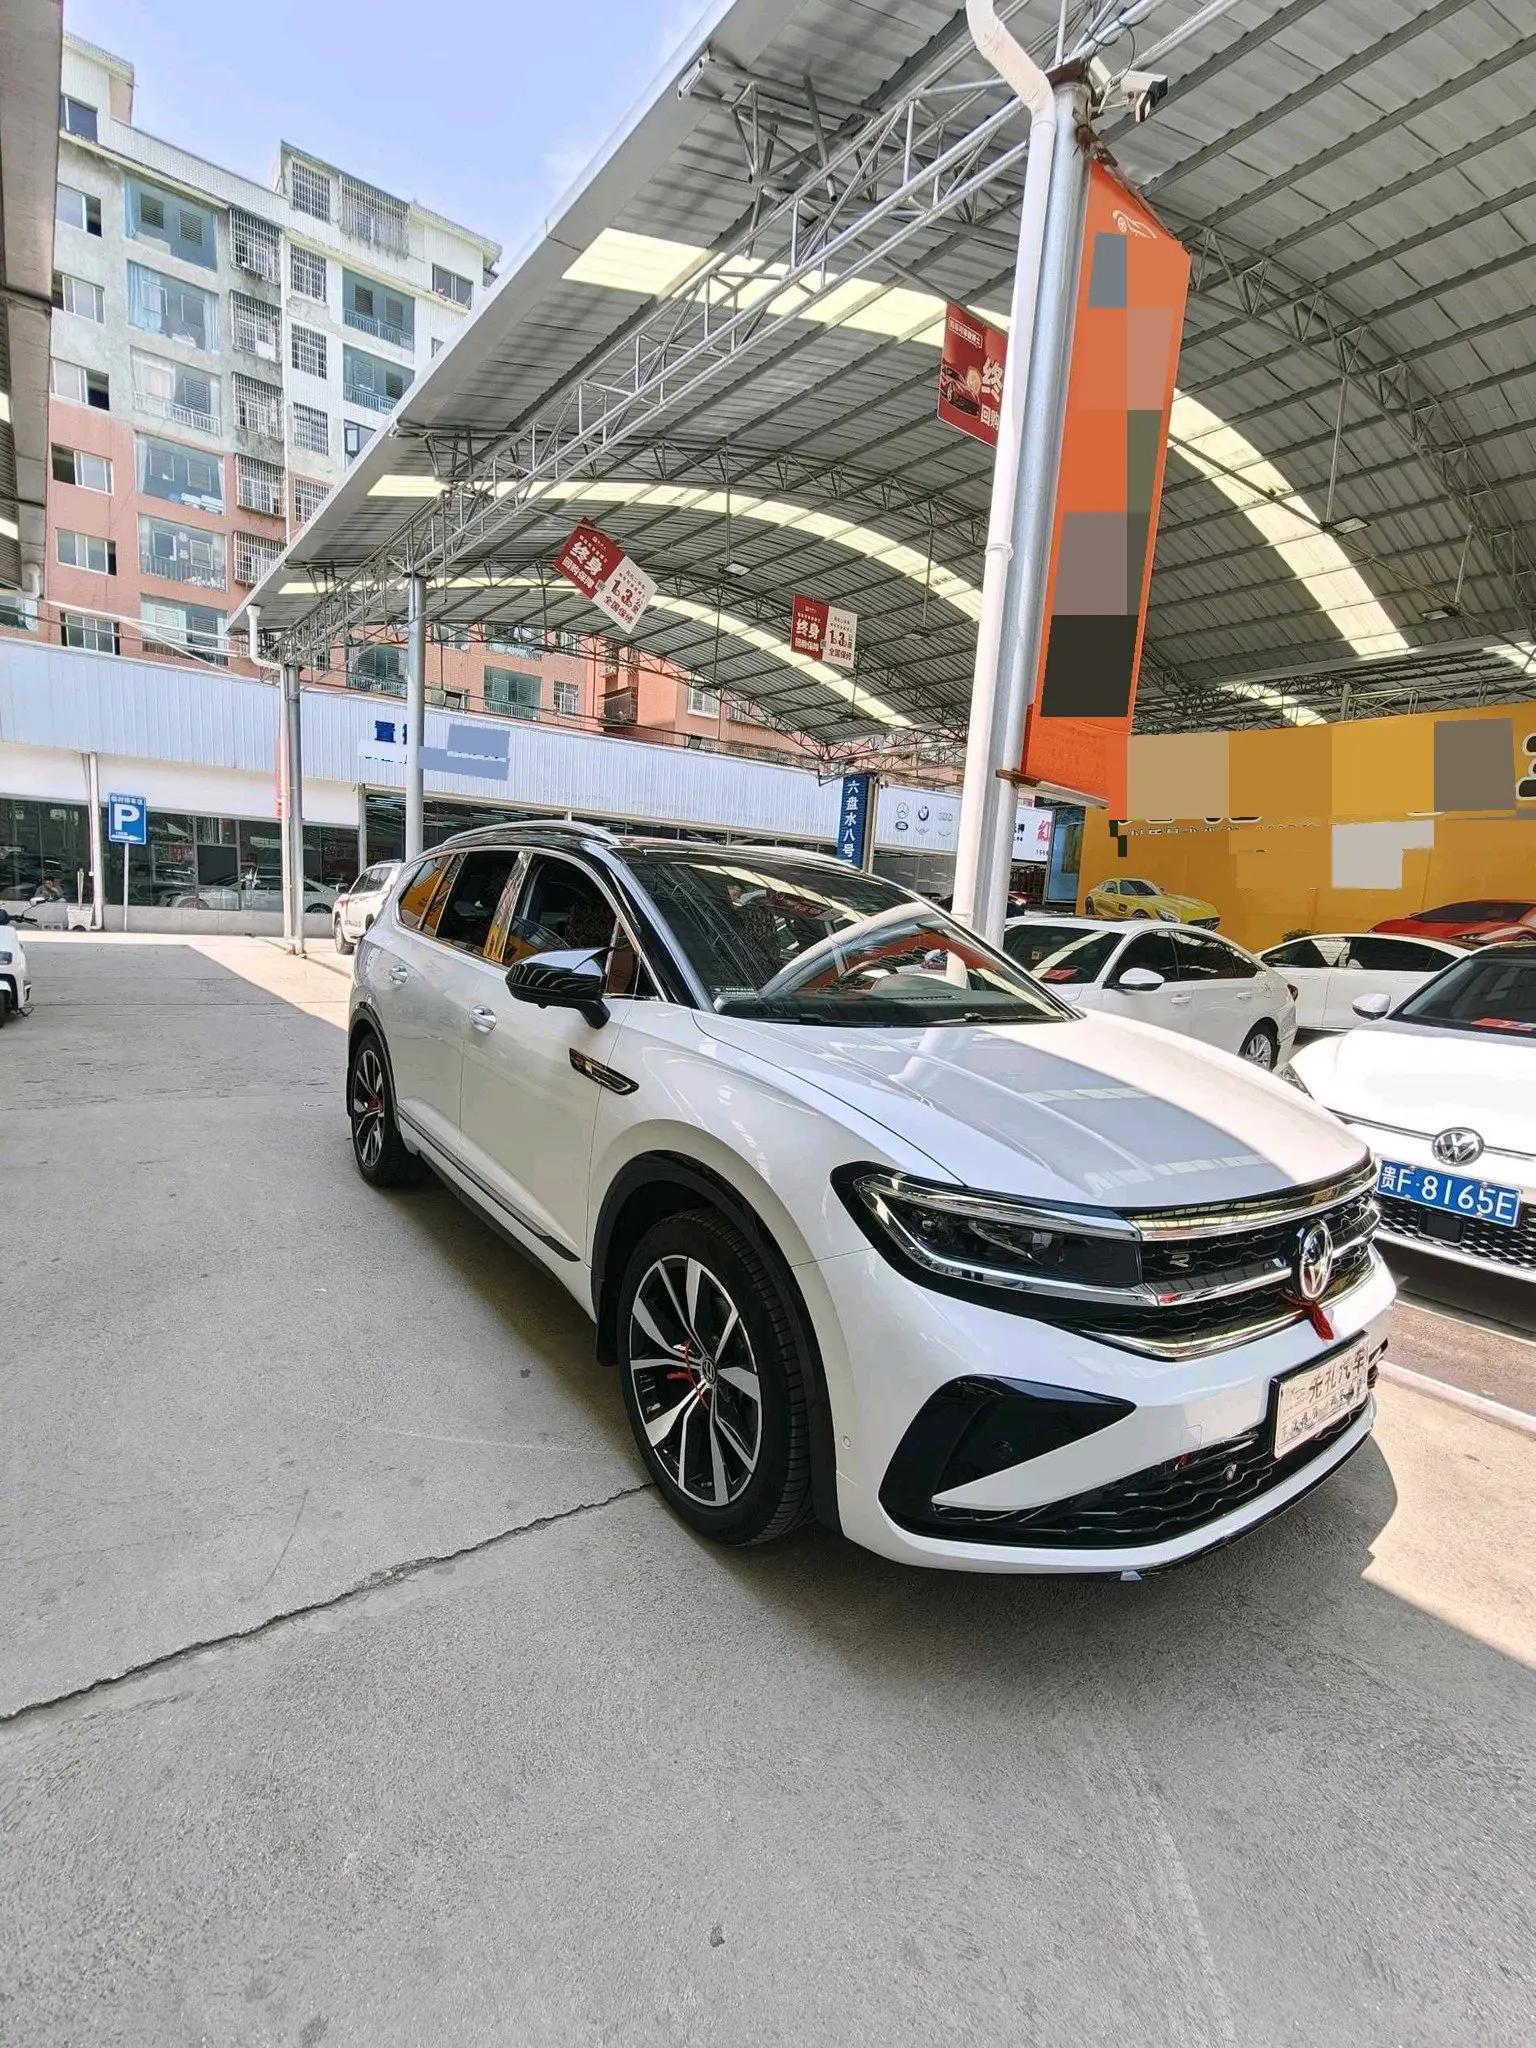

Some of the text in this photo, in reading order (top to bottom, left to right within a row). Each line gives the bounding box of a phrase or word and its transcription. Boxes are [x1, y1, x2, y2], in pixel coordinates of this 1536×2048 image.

[569, 541, 604, 576] 终身
[796, 618, 820, 640] 终身
[114, 803, 140, 831] P
